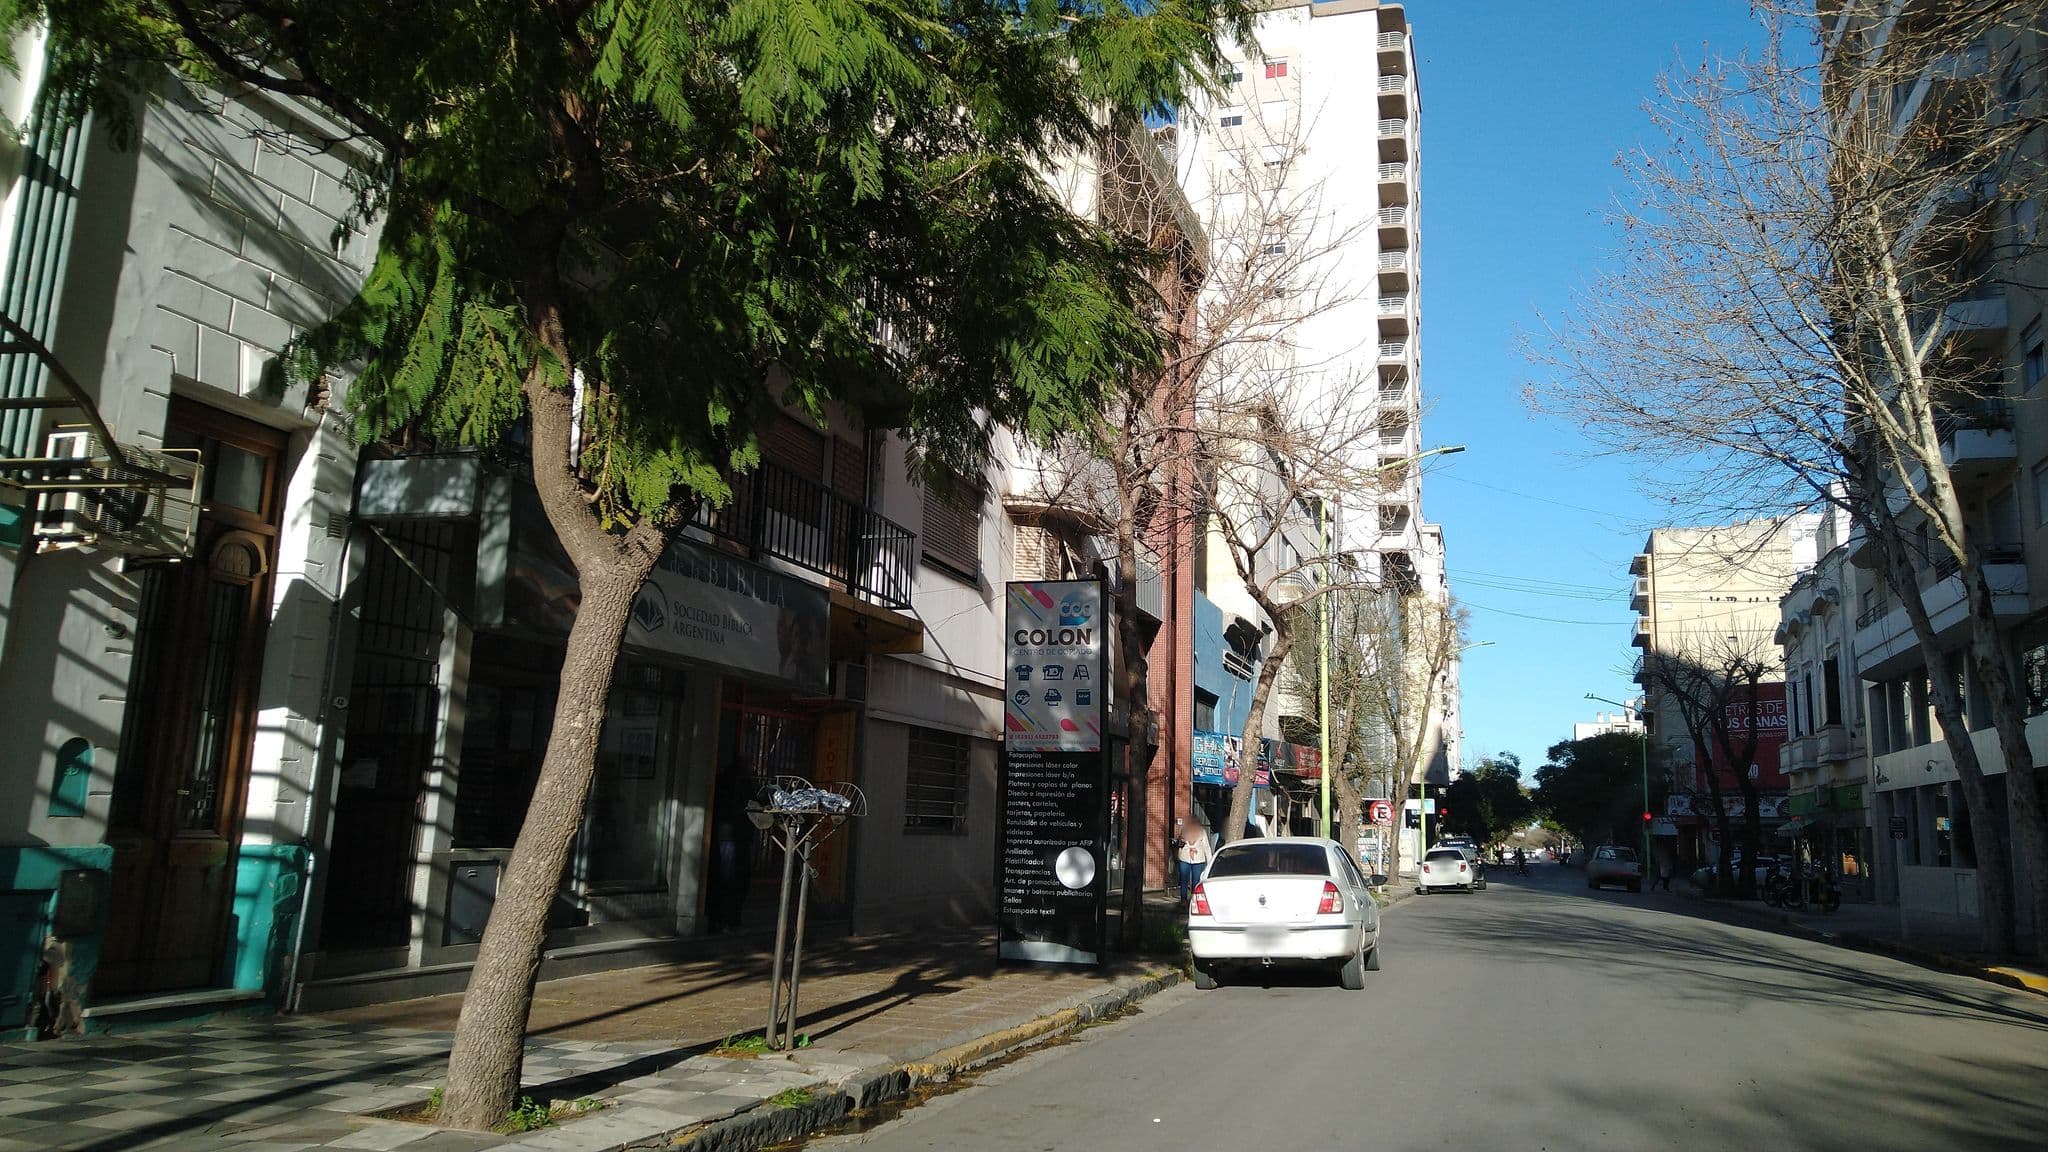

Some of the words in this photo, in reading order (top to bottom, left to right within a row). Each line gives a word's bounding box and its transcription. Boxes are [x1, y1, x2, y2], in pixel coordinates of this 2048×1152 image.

[708, 555, 786, 609] BIBLIA
[673, 600, 720, 627] SOCIEDAD
[673, 620, 726, 647] ARGENTINA
[1013, 628, 1092, 646] COLON
[1013, 648, 1044, 657] CENTRO
[1766, 702, 1784, 714] DE
[1008, 751, 1042, 759] Fotocopias
[1008, 761, 1044, 770] Impresiones
[1008, 771, 1044, 779] Impresiones
[1037, 781, 1058, 789] copias
[1006, 838, 1033, 846] Imprenta
[1005, 847, 1034, 855] Anillados
[1005, 857, 1044, 866] Plastificados
[1005, 867, 1051, 876] Transparencias
[1056, 889, 1093, 897] publicitarios
[1003, 896, 1022, 904] Sellos
[1003, 906, 1038, 915] Estampado
